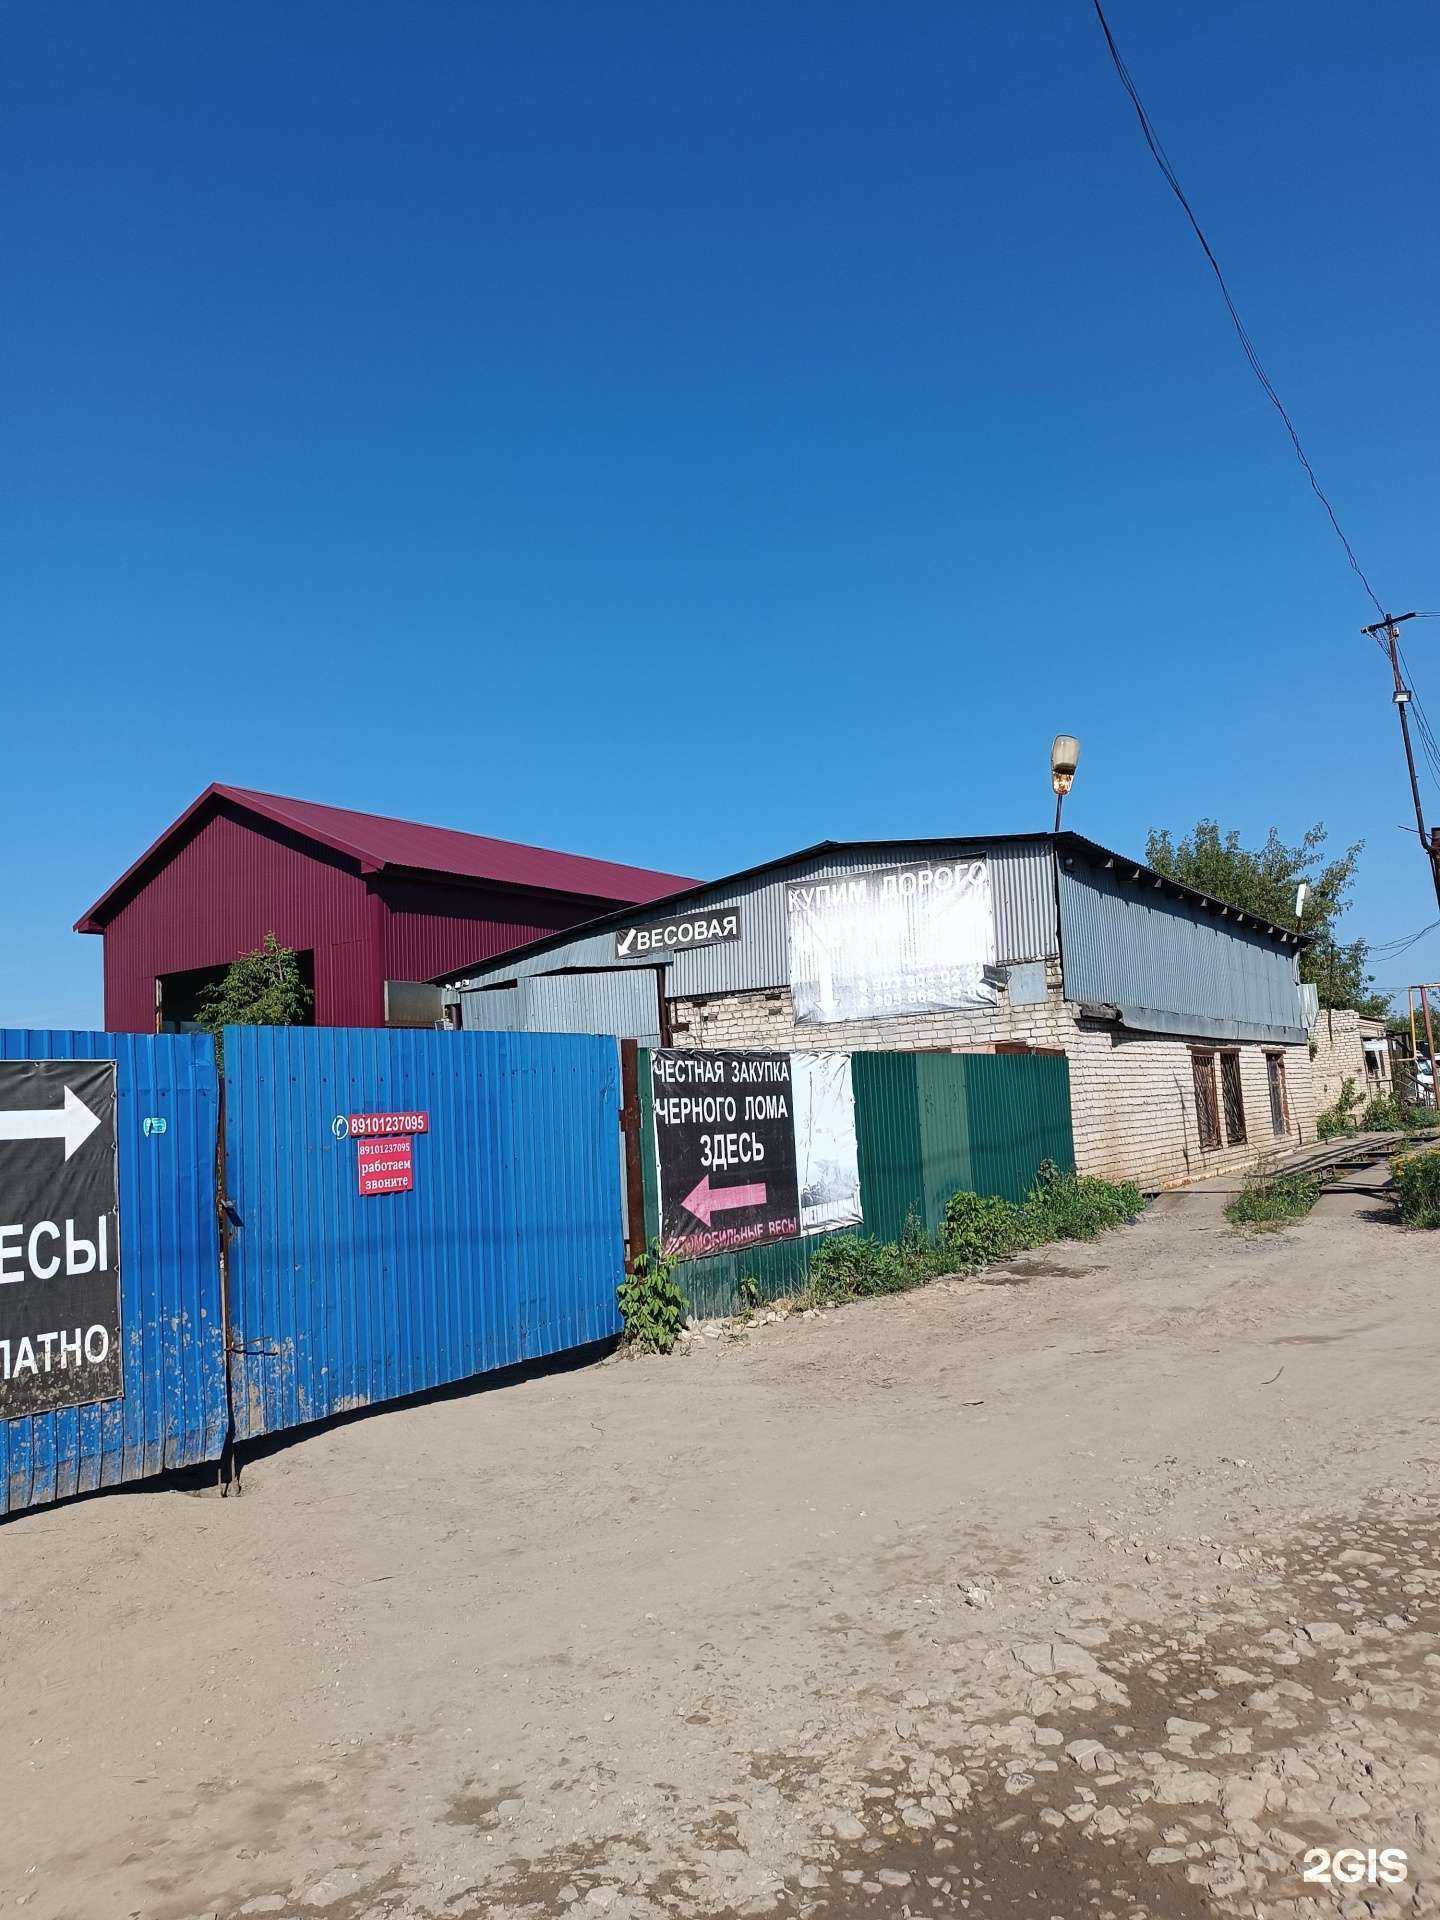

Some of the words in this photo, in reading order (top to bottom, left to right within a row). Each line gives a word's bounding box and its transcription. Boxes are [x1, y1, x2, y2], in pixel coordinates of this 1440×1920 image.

[788, 879, 867, 912] КУПИМ
[881, 861, 987, 900] ДОРОГО
[637, 915, 737, 951] ВЕСОВАЯ
[654, 1060, 724, 1083] ЧЕСТНАЯ
[731, 1061, 790, 1083] ЗАКУПКА
[656, 1096, 737, 1124] ЧЕРНОГО
[744, 1094, 789, 1121] ЛОМА
[351, 1115, 424, 1134] 89101237095
[359, 1142, 410, 1155] 89101237095
[700, 1132, 765, 1171] ЗДЕСЬ
[361, 1159, 411, 1176] работаем
[365, 1176, 408, 1190] звоните
[768, 1216, 797, 1236] ВЕСЫ
[0, 1215, 108, 1284] ЕСЫ
